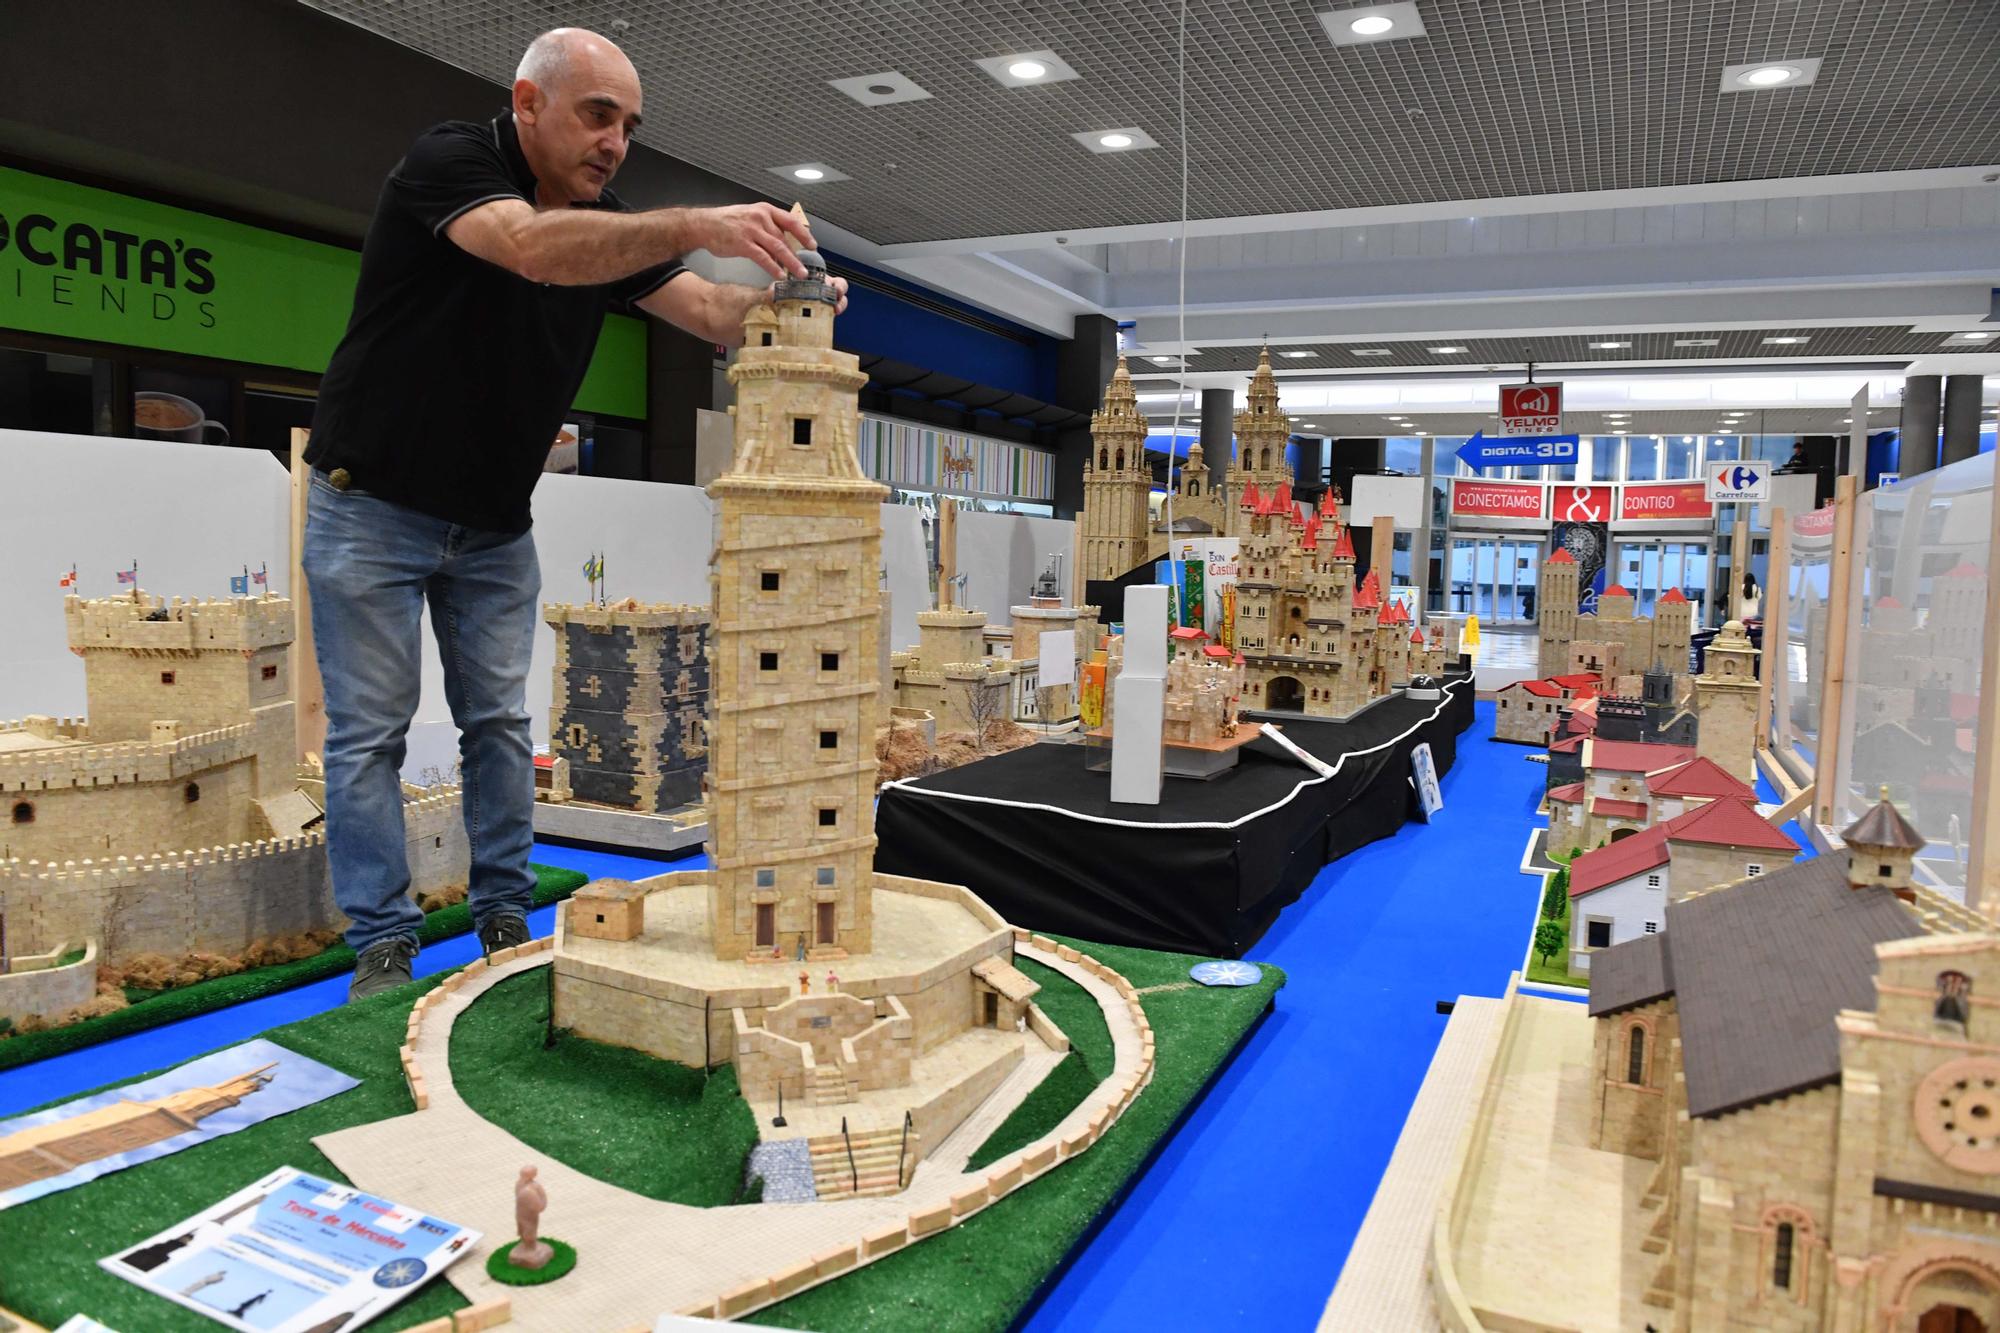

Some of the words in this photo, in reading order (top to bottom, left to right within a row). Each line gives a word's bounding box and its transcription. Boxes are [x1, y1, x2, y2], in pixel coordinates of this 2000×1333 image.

[0, 213, 216, 295] CATA'S
[16, 268, 216, 329] IENDS
[1502, 417, 1559, 428] YELMO
[1481, 446, 1534, 456] DIGITAL
[1536, 443, 1573, 457] 3D
[1458, 492, 1540, 509] CONECTAMOS
[1624, 495, 1675, 510] CONTIGO
[1208, 563, 1238, 576] Castill
[282, 1200, 318, 1218] Torre
[321, 1213, 342, 1227] de
